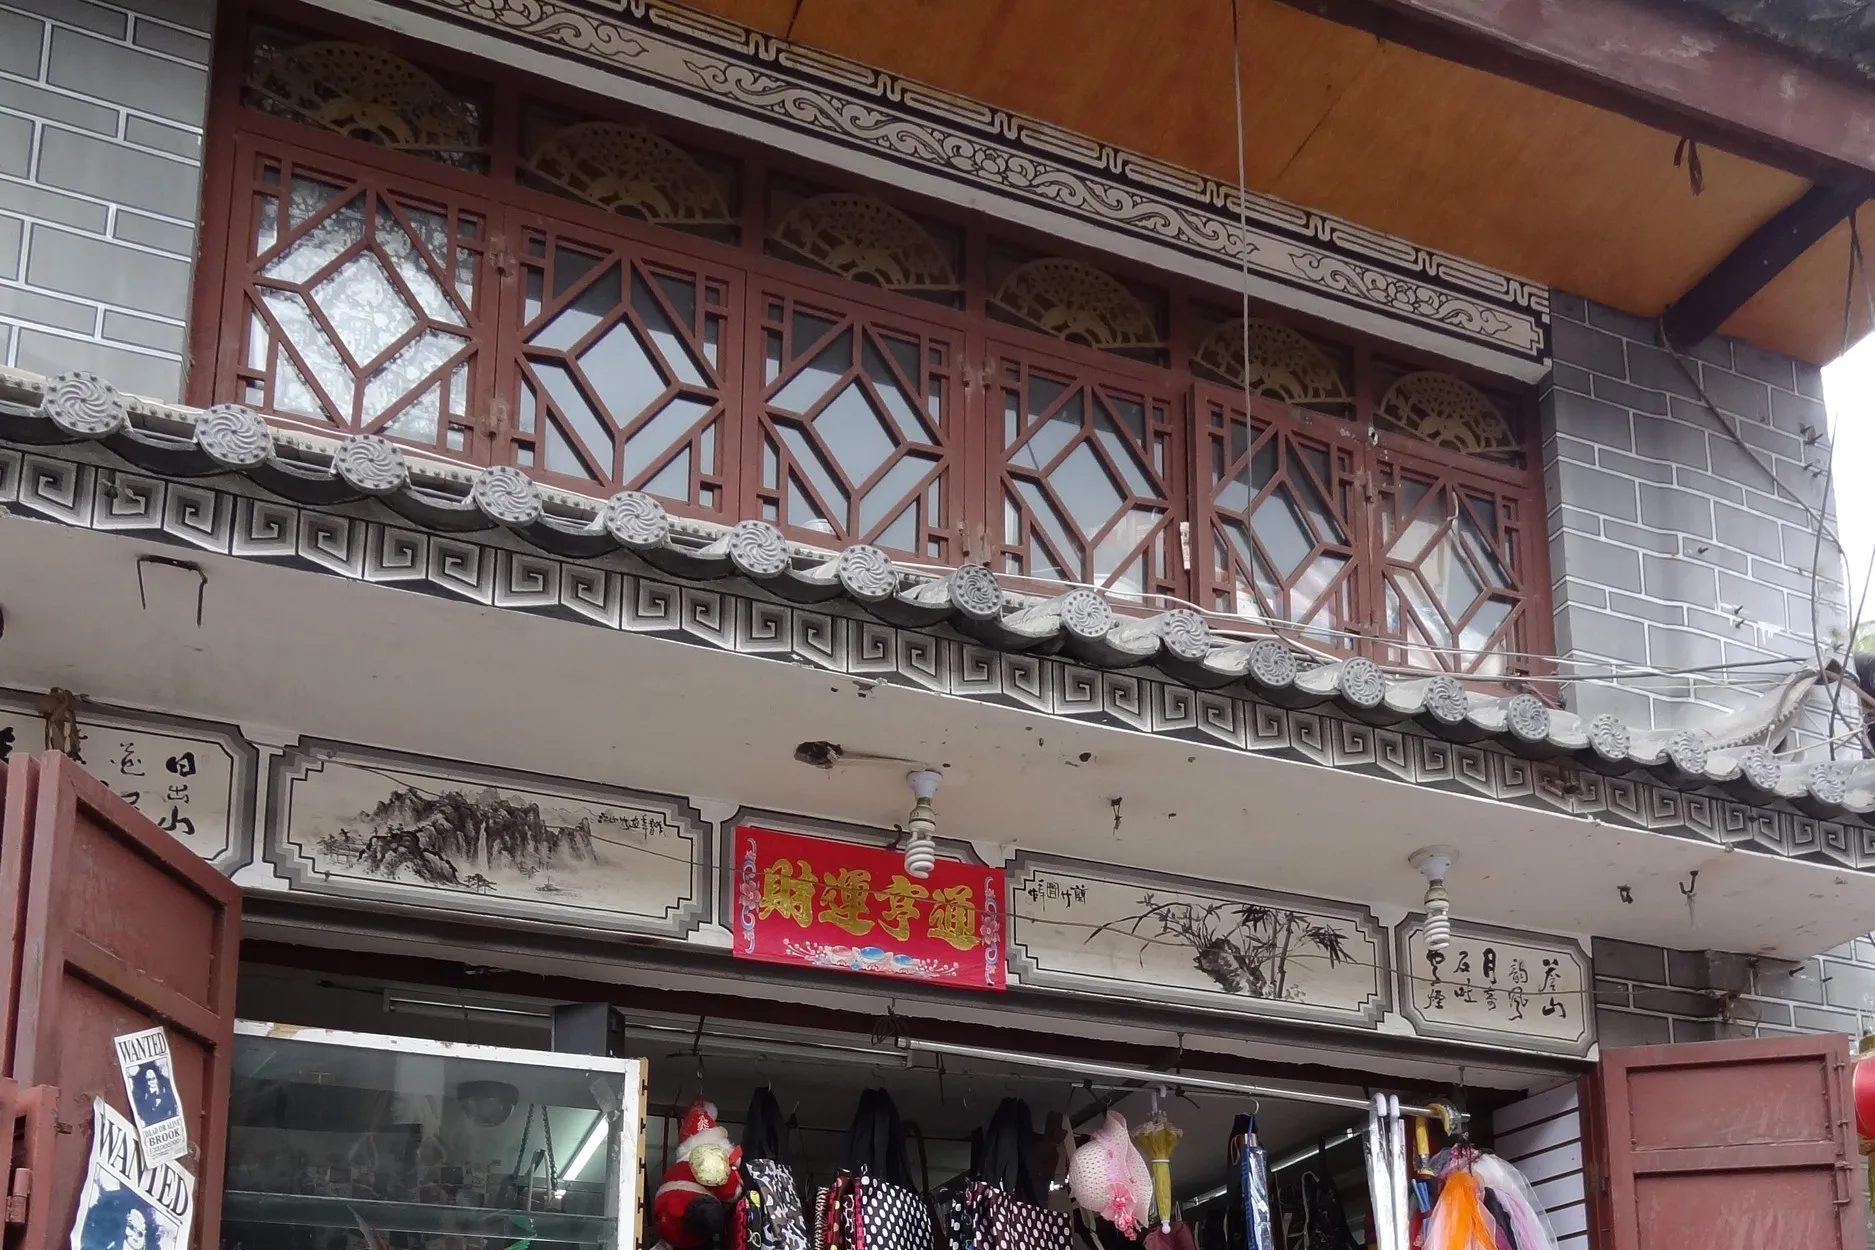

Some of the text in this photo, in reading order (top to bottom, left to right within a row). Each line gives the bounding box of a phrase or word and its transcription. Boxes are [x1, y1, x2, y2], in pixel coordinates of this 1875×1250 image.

[758, 858, 982, 951] 財運亨通
[118, 1031, 167, 1064] WANTED
[149, 1128, 181, 1146] BROOK
